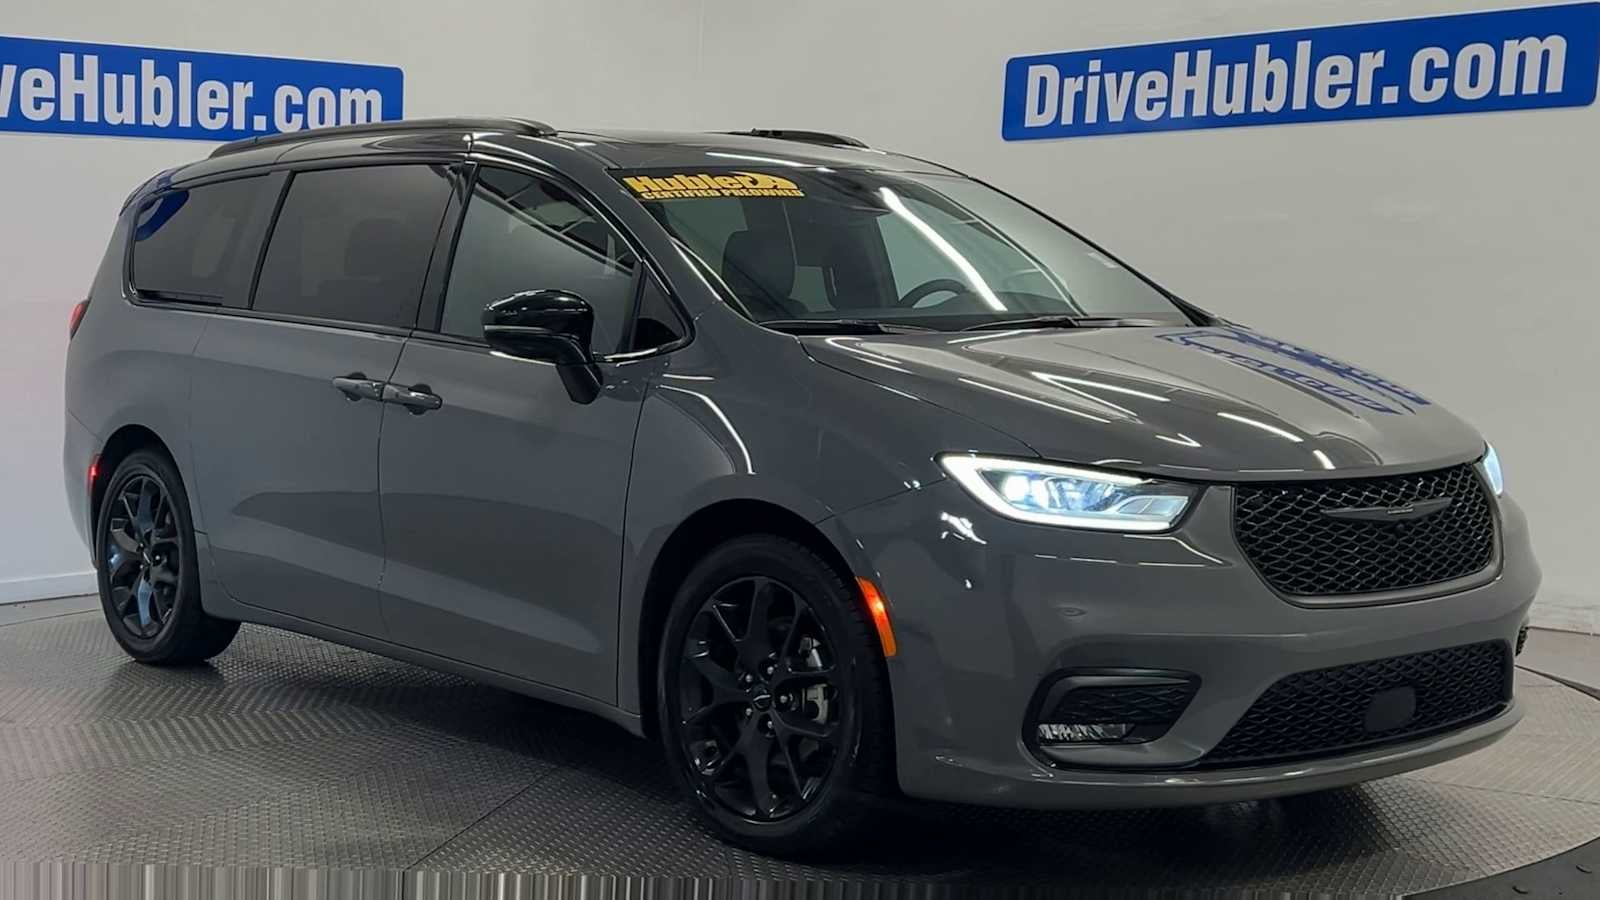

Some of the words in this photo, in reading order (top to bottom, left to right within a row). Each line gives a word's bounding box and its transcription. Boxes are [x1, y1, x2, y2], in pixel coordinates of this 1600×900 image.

[1023, 34, 1568, 128] DriveHubler.com
[622, 173, 754, 193] Hubler
[640, 189, 721, 200] CERTIFIED
